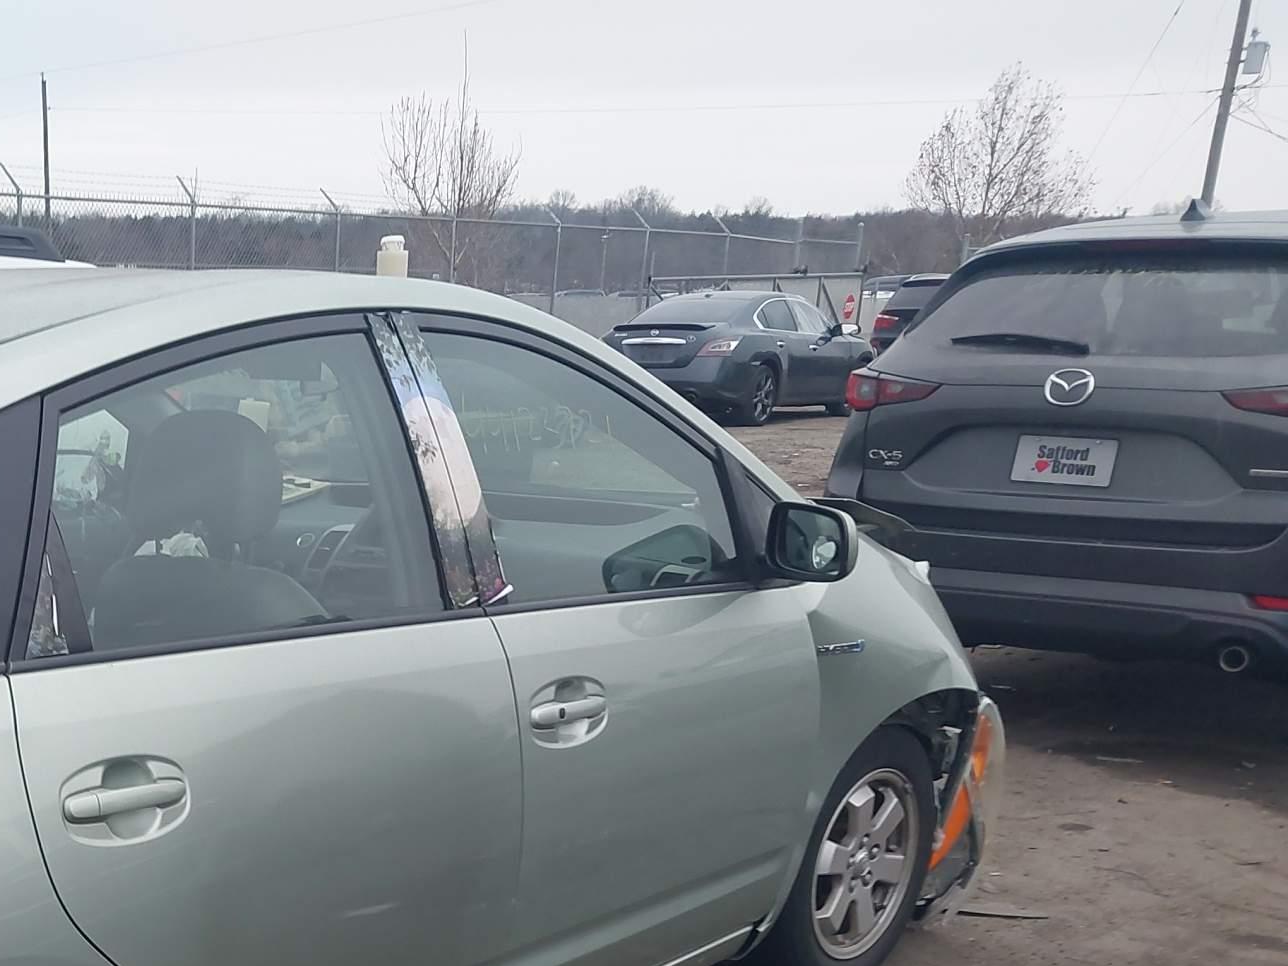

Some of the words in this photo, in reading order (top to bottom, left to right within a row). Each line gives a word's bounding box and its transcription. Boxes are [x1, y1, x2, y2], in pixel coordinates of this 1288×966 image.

[868, 448, 903, 461] CX-5
[1037, 444, 1090, 462] Safford
[1051, 460, 1097, 477] Brown
